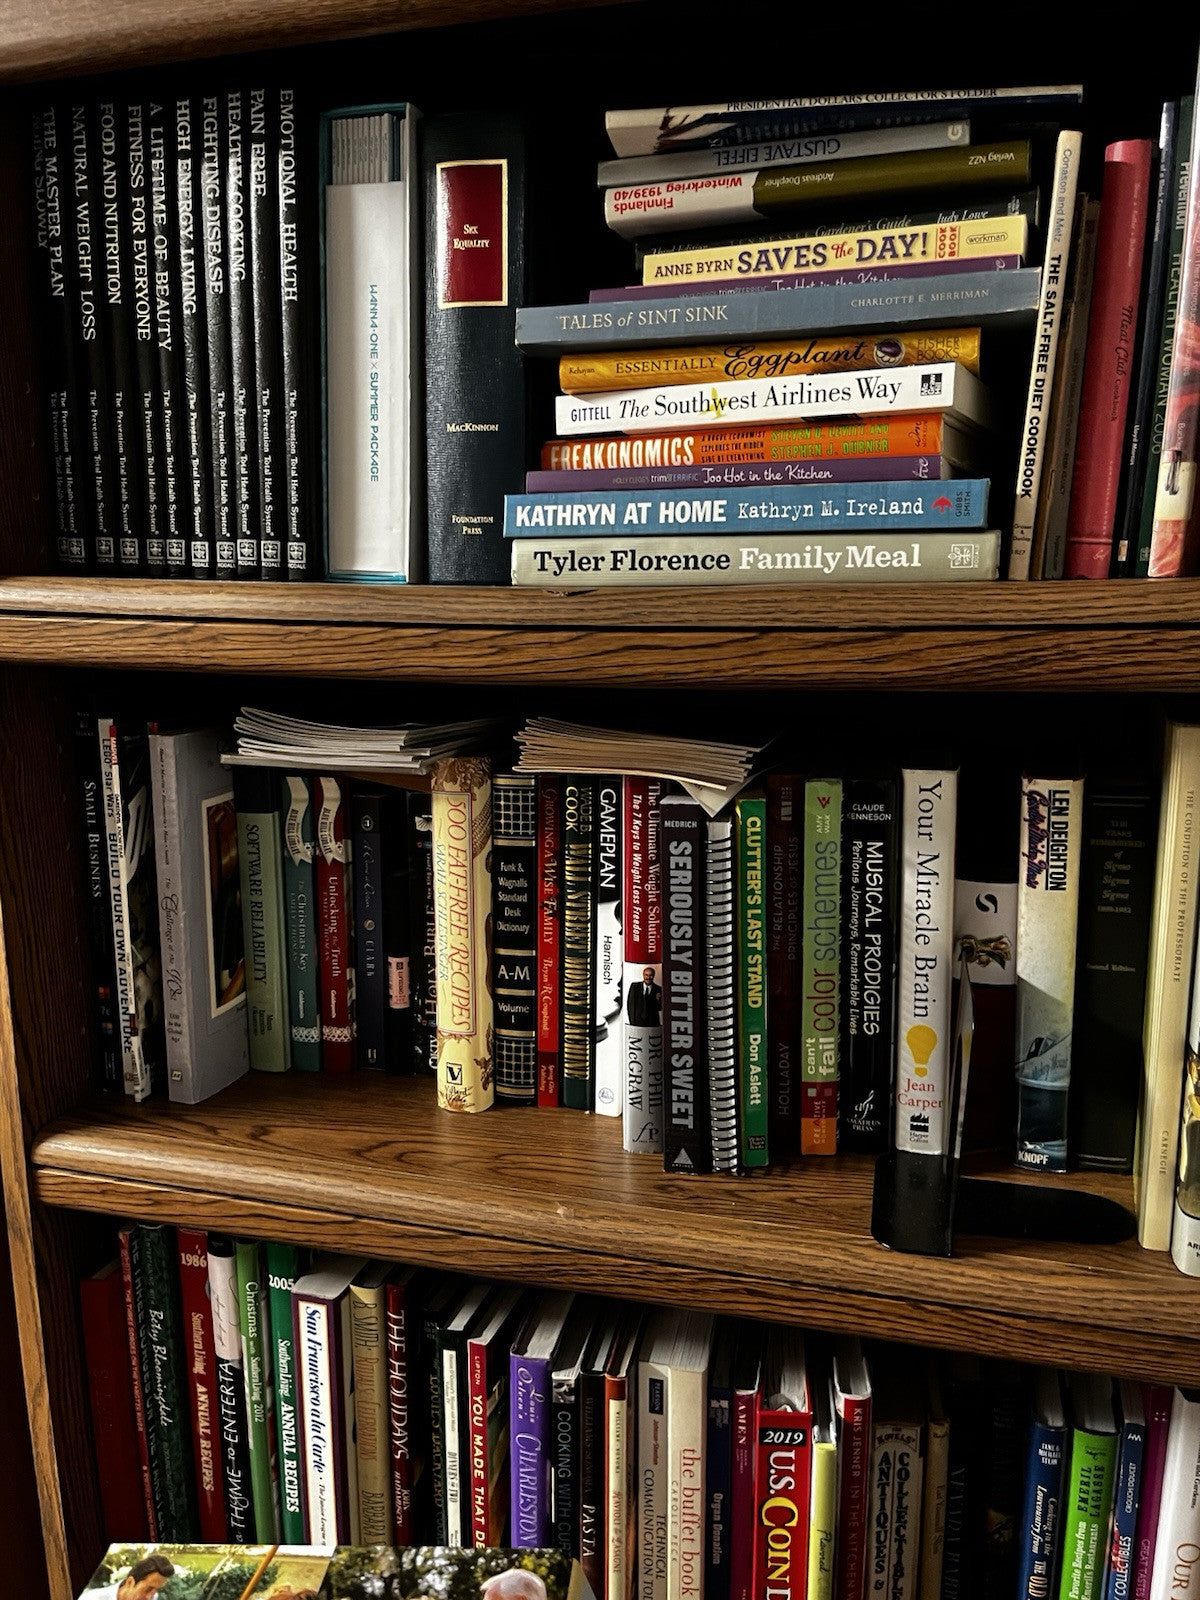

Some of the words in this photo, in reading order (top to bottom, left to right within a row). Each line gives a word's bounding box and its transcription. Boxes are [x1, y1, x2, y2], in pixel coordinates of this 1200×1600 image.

[100, 104, 115, 154] FOOD
[128, 105, 144, 187] FITNESS
[177, 100, 190, 150] HIGH
[72, 107, 87, 196] NATURAL
[203, 97, 220, 199] FIGHTING
[279, 89, 296, 211] EMOTIONAL
[713, 146, 758, 167] EIFFEL
[763, 138, 840, 162] GUSTAVE
[103, 159, 117, 198] AND
[614, 186, 662, 202] 1939/40
[666, 177, 743, 193] Winterkrieg
[1057, 149, 1073, 195] Conason
[132, 196, 145, 233] FOR
[178, 159, 193, 239] ENERGY
[614, 197, 673, 215] Finnlands
[1056, 197, 1068, 214] and
[77, 202, 92, 281] WEIGHT
[207, 206, 223, 294] DISEASE
[1053, 216, 1066, 243] Metz
[105, 203, 121, 304] NUTRITION
[282, 223, 297, 301] HEALTH
[654, 263, 693, 278] ANNE
[696, 259, 734, 273] BYRN
[737, 234, 828, 273] SAVES
[831, 243, 854, 258] the
[855, 232, 928, 261] DAY!
[1047, 255, 1061, 285] THE
[133, 239, 150, 340] EVERYONE
[181, 248, 196, 315] LIVING
[851, 296, 914, 308] CHARLOTTE
[930, 289, 989, 302] MERRIMAN
[81, 291, 95, 340] LOSS
[559, 312, 612, 330] TALES
[618, 311, 632, 327] of
[637, 308, 679, 325] SINT
[684, 305, 728, 322] SINK
[1035, 291, 1057, 374] SALT-FREE
[615, 357, 717, 375] ESSENTIALLY
[722, 340, 869, 379] Eggplant
[369, 372, 379, 422] SUMMER
[571, 404, 611, 423] GITTELL
[619, 399, 650, 419] The
[654, 390, 758, 417] Southwest
[763, 383, 852, 409] Airlines
[856, 377, 902, 402] Way
[1031, 378, 1048, 409] DIET
[289, 411, 298, 454] Prevention
[369, 426, 379, 482] PACKAGE
[550, 437, 694, 470] FREAKONOMICS
[771, 443, 825, 458] STEPHEN
[842, 438, 888, 454] DUBNER
[291, 457, 299, 477] Total
[701, 467, 722, 484] Too
[724, 467, 745, 483] Hot
[748, 469, 759, 481] in
[763, 467, 778, 480] the
[782, 465, 832, 481] Kitchen
[1020, 416, 1043, 498] COOKBOOK
[291, 480, 299, 504] Health
[516, 503, 619, 528] KATHRYN
[624, 503, 652, 525] AT
[659, 501, 727, 523] HOME
[737, 500, 815, 521] Kathryn
[820, 500, 839, 518] M.
[846, 497, 923, 517] Ireland
[534, 550, 605, 578] Tyler
[610, 549, 730, 571] Florence
[738, 545, 841, 574] Family
[846, 543, 921, 568] Meal
[566, 786, 578, 832] COOK
[632, 795, 641, 810] The
[648, 784, 660, 807] The
[915, 780, 942, 841] Your
[1050, 790, 1069, 816] LEN
[446, 801, 467, 842] 500
[600, 788, 615, 887] GAMEPLAN
[630, 820, 641, 839] Keys
[648, 810, 660, 860] Ultimate
[108, 833, 120, 877] BUILD
[245, 824, 262, 896] SOFTWARE
[631, 853, 642, 883] Weight
[632, 842, 640, 850] to
[745, 816, 761, 905] CLUTTER'S
[850, 840, 861, 882] Perilous
[1048, 822, 1068, 890] DEIGHTON
[112, 884, 124, 924] YOUR
[327, 876, 340, 933] Unlocking
[447, 846, 471, 936] FAT-FREE
[632, 885, 641, 904] Loss
[645, 863, 659, 902] Weight
[669, 841, 691, 963] SERIOUSLY
[863, 841, 882, 928] MUSICAL
[913, 851, 940, 946] Miracle
[296, 894, 309, 950] Christmas
[632, 907, 642, 942] Freedom
[647, 905, 658, 953] Solution
[747, 909, 762, 952] LAST
[848, 886, 861, 940] Journeys,
[116, 929, 127, 963] OWN
[249, 901, 267, 985] RELIABILITY
[296, 953, 308, 972] Key
[331, 947, 342, 977] Truth
[602, 935, 614, 985] Harnisch
[450, 944, 474, 1030] RECIPES
[747, 955, 762, 1008] STAND
[849, 943, 860, 1006] Remarkable
[863, 933, 881, 1035] PRODIGIES
[912, 956, 937, 1018] Brain
[671, 970, 692, 1049] BITTER
[849, 1008, 859, 1035] Lives
[750, 1034, 762, 1060] Don
[671, 1054, 693, 1129] SWEET
[750, 1063, 762, 1105] Aslett
[1158, 1130, 1170, 1176] CARNEGIE
[268, 1275, 295, 1290] 2005
[305, 1307, 320, 1336] San
[387, 1310, 407, 1352] THE
[246, 1282, 259, 1337] Christmas
[254, 1404, 264, 1422] 2012
[306, 1339, 323, 1407] Francisco
[282, 1401, 296, 1455] ANNUAL
[389, 1357, 409, 1459] HOLIDAYS
[473, 1395, 484, 1427] YOU
[737, 1402, 747, 1445] AMEN
[853, 1408, 863, 1432] KRIS
[473, 1434, 485, 1479] MADE
[558, 1411, 571, 1478] COOKING
[764, 1430, 803, 1445] 2019
[852, 1436, 862, 1477] JENNER
[284, 1459, 299, 1512] RECIPES
[682, 1448, 700, 1480] the
[768, 1450, 795, 1495] U.S.
[474, 1486, 485, 1523] THAT
[558, 1484, 571, 1518] WITH
[682, 1487, 700, 1544] buffet
[582, 1504, 595, 1557] PASTA
[656, 1514, 666, 1580] TECHNICAL
[682, 1551, 700, 1596] book
